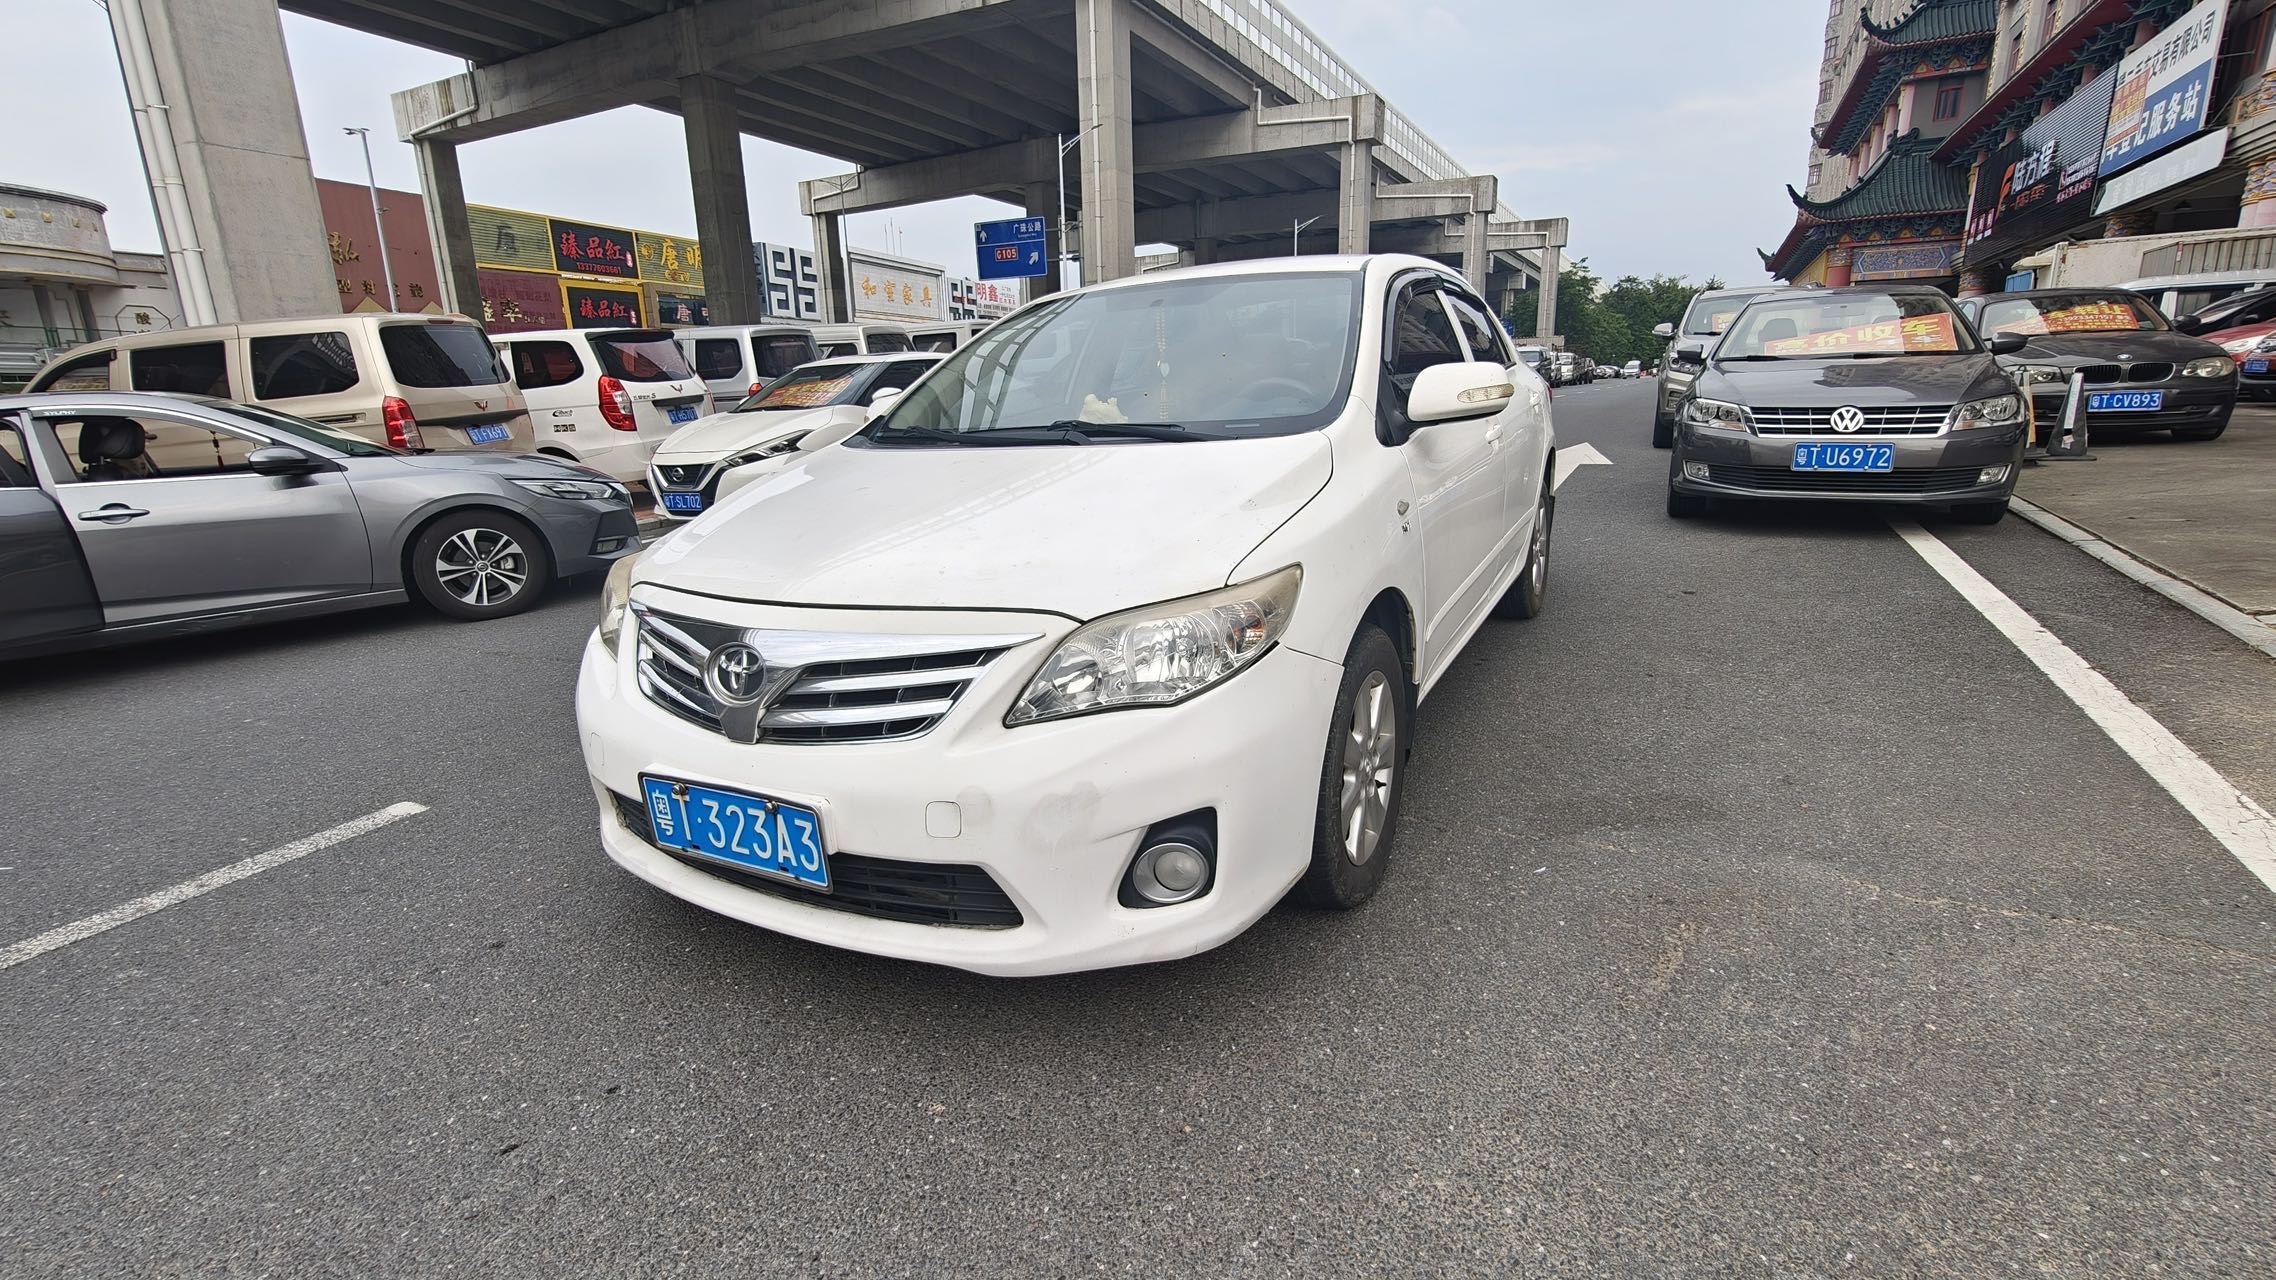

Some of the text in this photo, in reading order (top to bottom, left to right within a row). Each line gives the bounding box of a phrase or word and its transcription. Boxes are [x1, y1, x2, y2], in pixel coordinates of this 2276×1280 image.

[1013, 221, 1041, 234] 广珠公路
[996, 249, 1017, 259] G105
[976, 283, 999, 302] 明鑫
[1796, 447, 1890, 467] 粤T·U6972
[652, 789, 819, 872] 粤T·323A3
